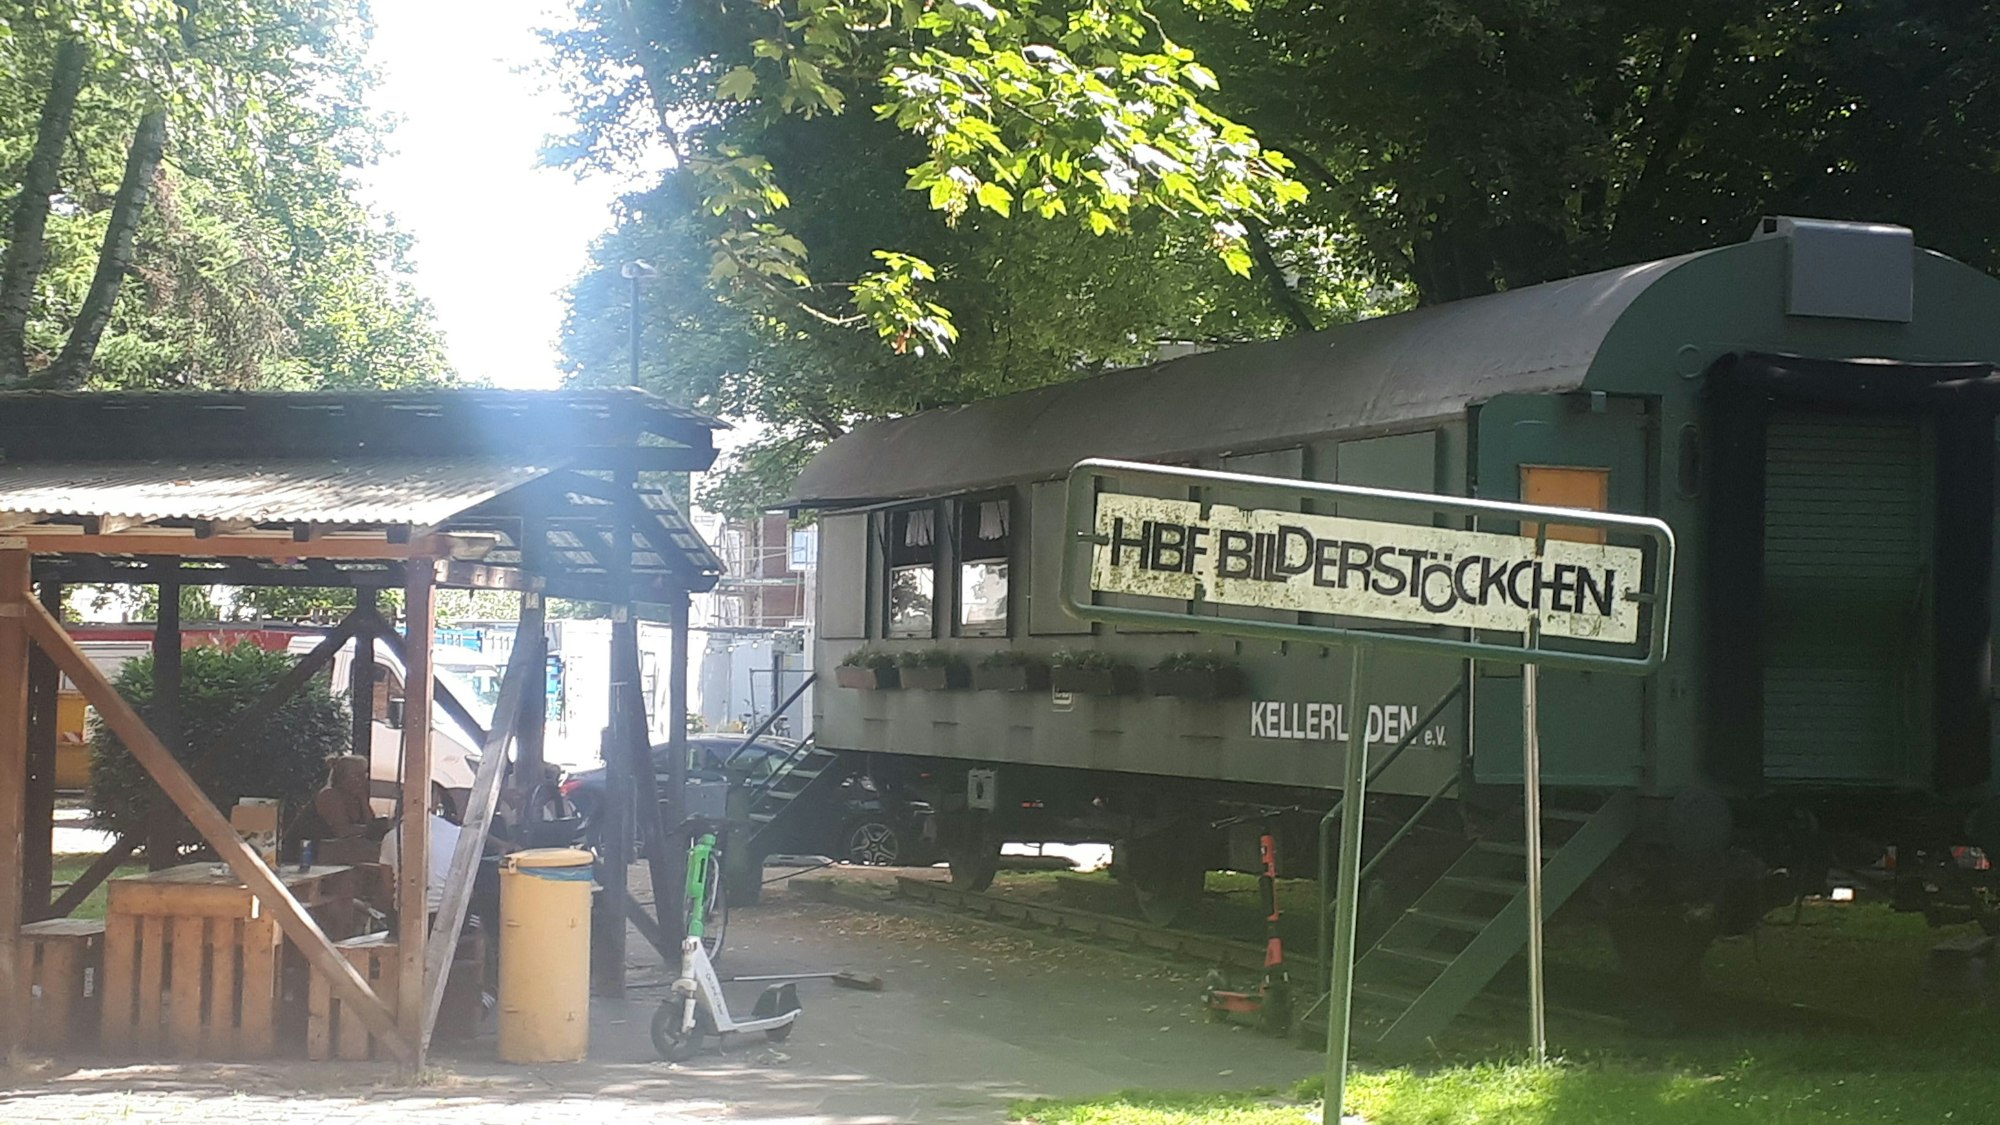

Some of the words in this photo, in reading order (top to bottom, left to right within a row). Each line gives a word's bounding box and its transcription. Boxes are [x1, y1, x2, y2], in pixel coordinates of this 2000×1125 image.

[1111, 517, 1210, 574] HBF
[1218, 525, 1617, 616] BILDERSTÖCKCHEN
[1251, 702, 1418, 744] KELLERLDEN
[1424, 725, 1446, 746] e.V.
